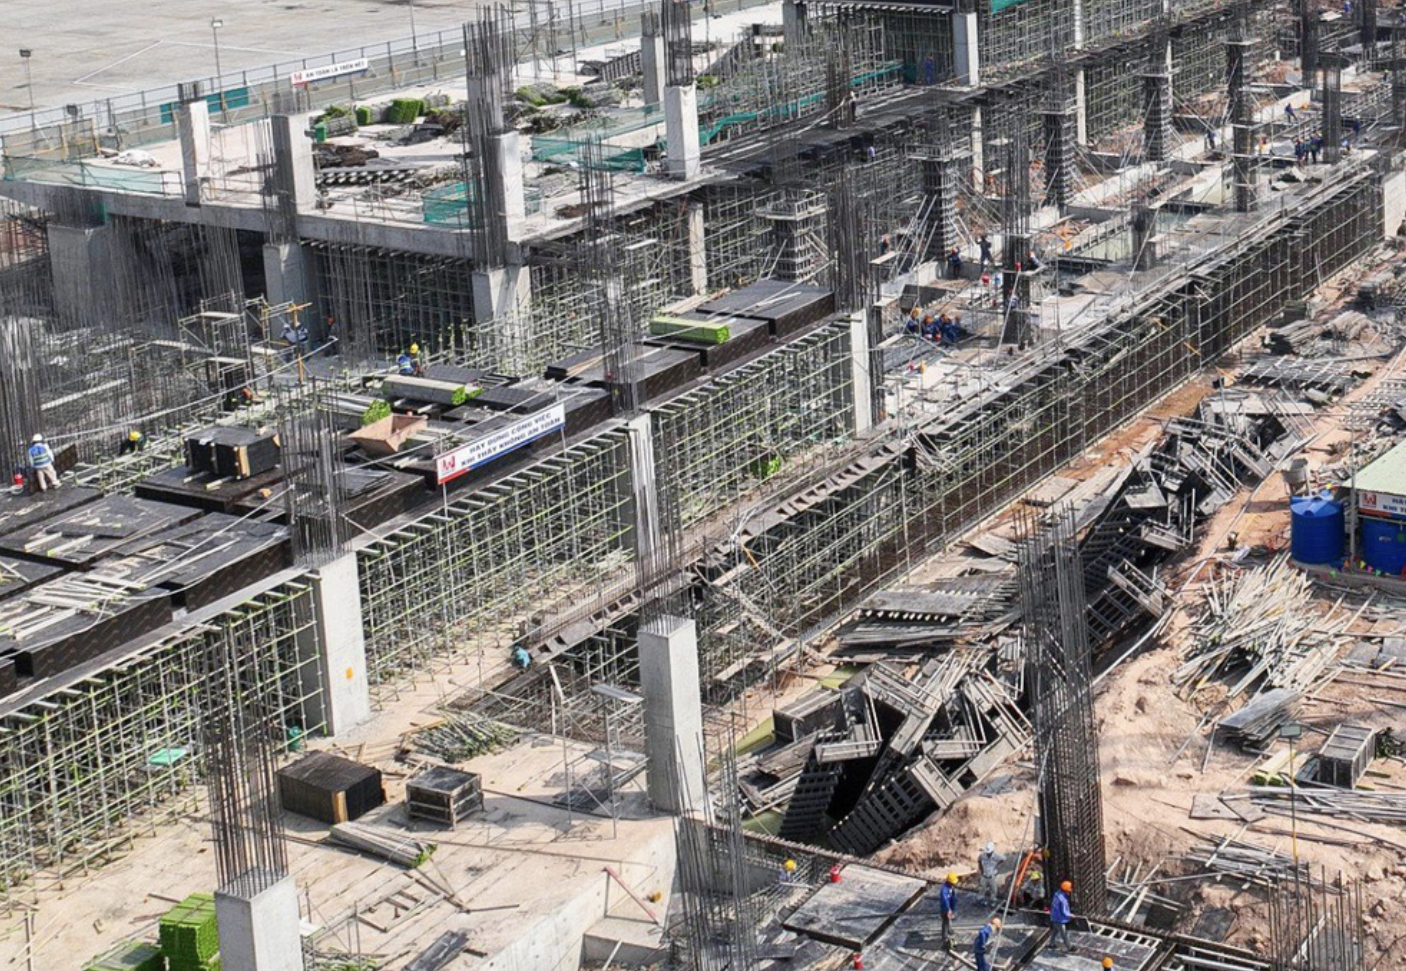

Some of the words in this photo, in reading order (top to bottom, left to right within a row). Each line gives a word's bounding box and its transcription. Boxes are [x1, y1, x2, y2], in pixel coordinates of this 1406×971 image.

[461, 456, 476, 467] KHI
[499, 432, 526, 449] KHÔNG
[527, 427, 539, 438] AN
[541, 417, 560, 430] TOÀN
[1382, 504, 1398, 512] KHI
